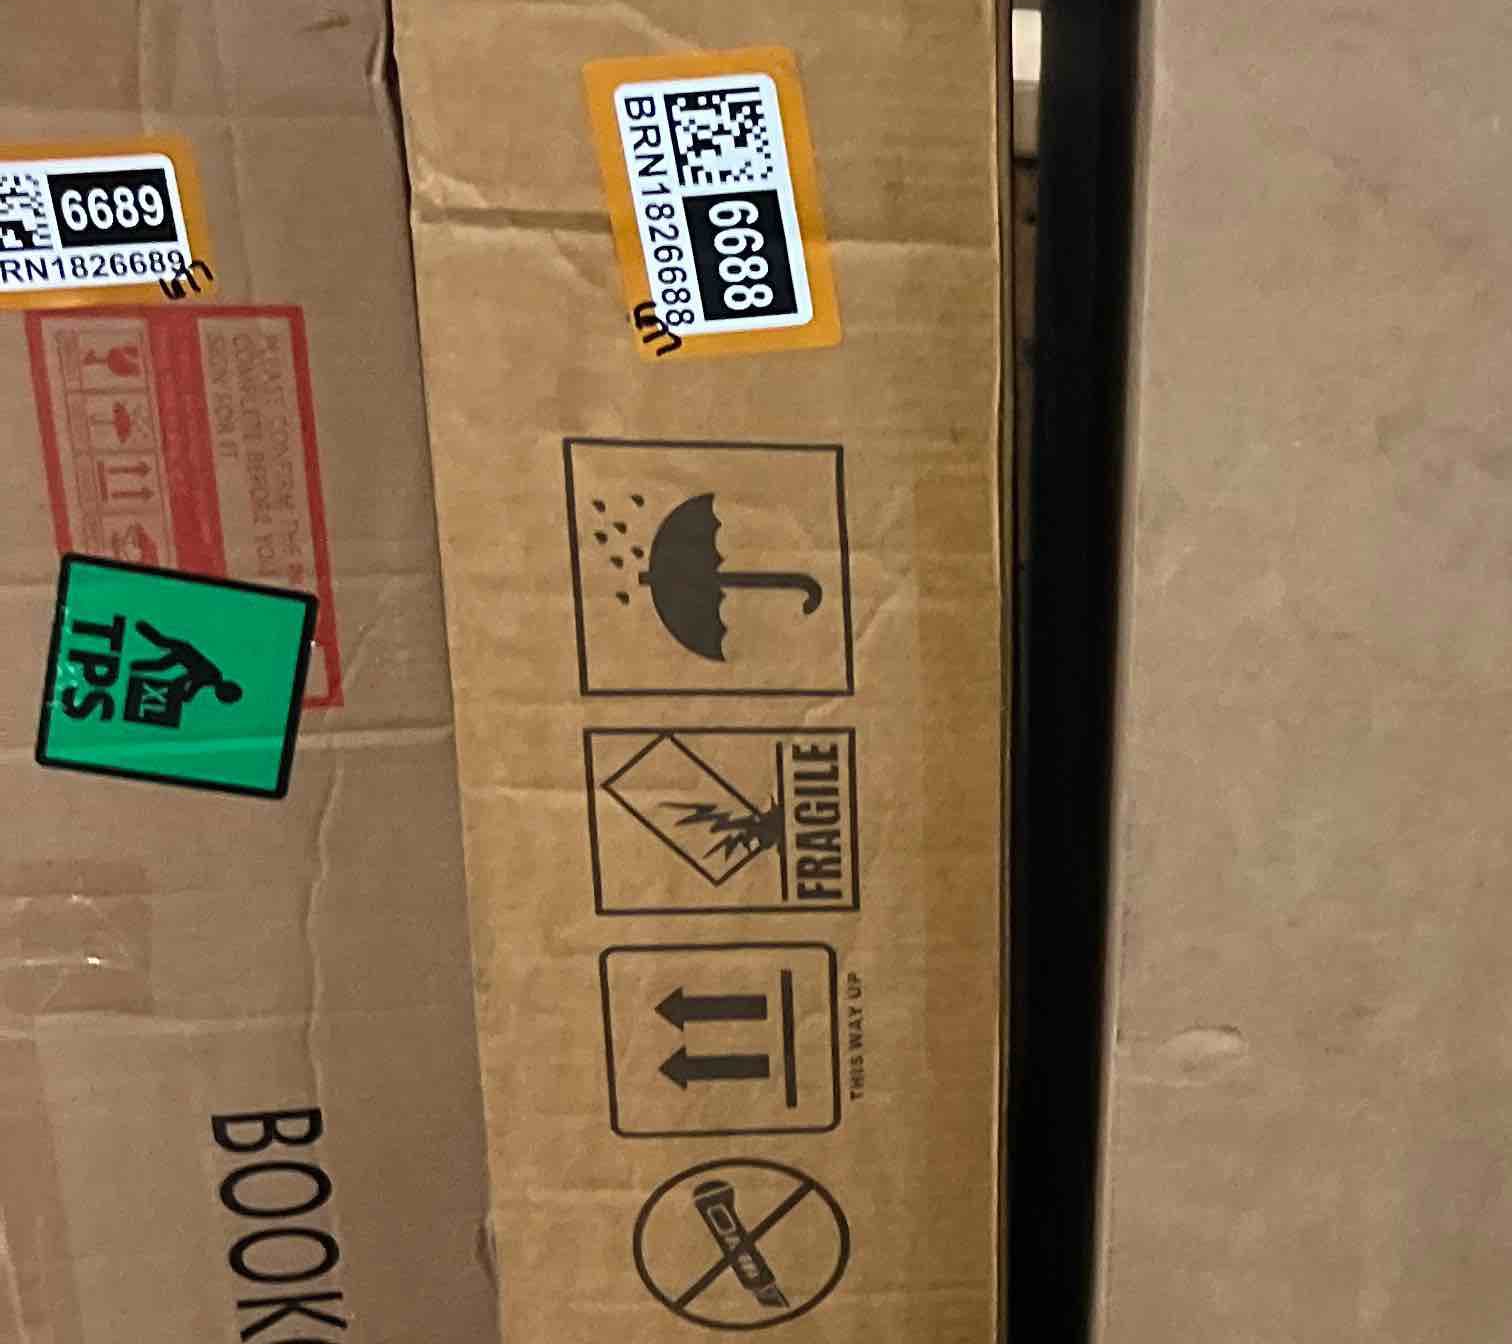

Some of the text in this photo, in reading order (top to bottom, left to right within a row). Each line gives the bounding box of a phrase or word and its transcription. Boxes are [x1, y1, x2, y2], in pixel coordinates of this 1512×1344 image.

[61, 185, 164, 231] 6689
[625, 97, 694, 326] BRN1826688
[709, 201, 773, 310] 6688
[61, 615, 126, 722] TPS
[139, 685, 168, 717] XL
[792, 743, 842, 900] FRAGILE
[847, 973, 864, 1101] THIS WAY UP
